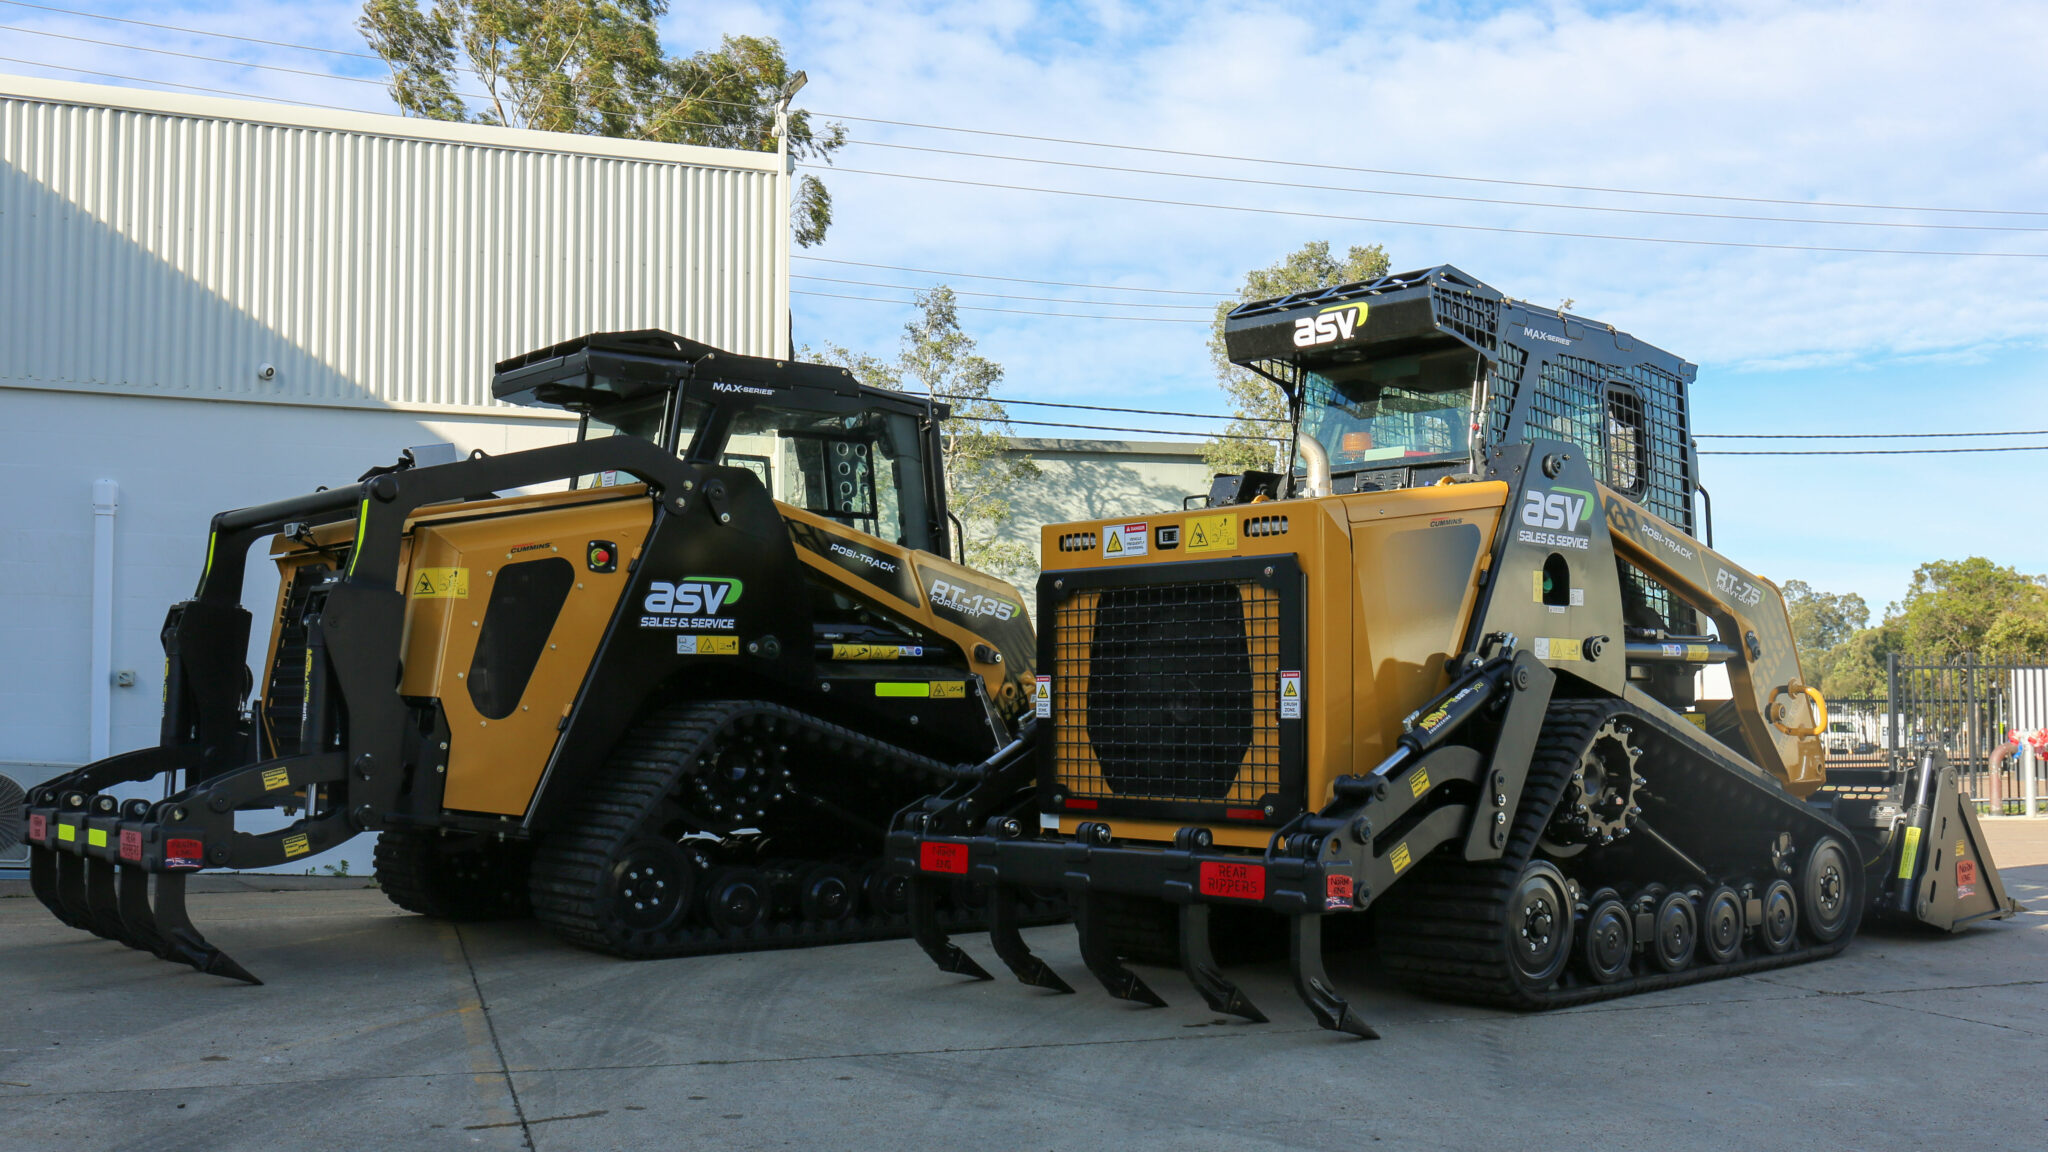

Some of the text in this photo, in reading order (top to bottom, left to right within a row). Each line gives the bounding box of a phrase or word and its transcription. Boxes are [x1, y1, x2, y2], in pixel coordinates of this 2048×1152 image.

[1430, 518, 1463, 527] CUMMINS
[511, 543, 552, 554] CUMMINS
[1547, 533, 1556, 545] &
[1556, 535, 1589, 550] SERVICE
[1641, 524, 1693, 560] POSI-TRACK
[830, 543, 896, 573] POSI-TRACK
[1716, 567, 1761, 605] RT-75
[930, 579, 1014, 621] RT-135
[931, 595, 983, 618] FORESTRY
[678, 618, 689, 628] &
[690, 618, 735, 629] SERVICE
[1218, 865, 1248, 878] REAR
[1208, 878, 1257, 893] RIPPERS
